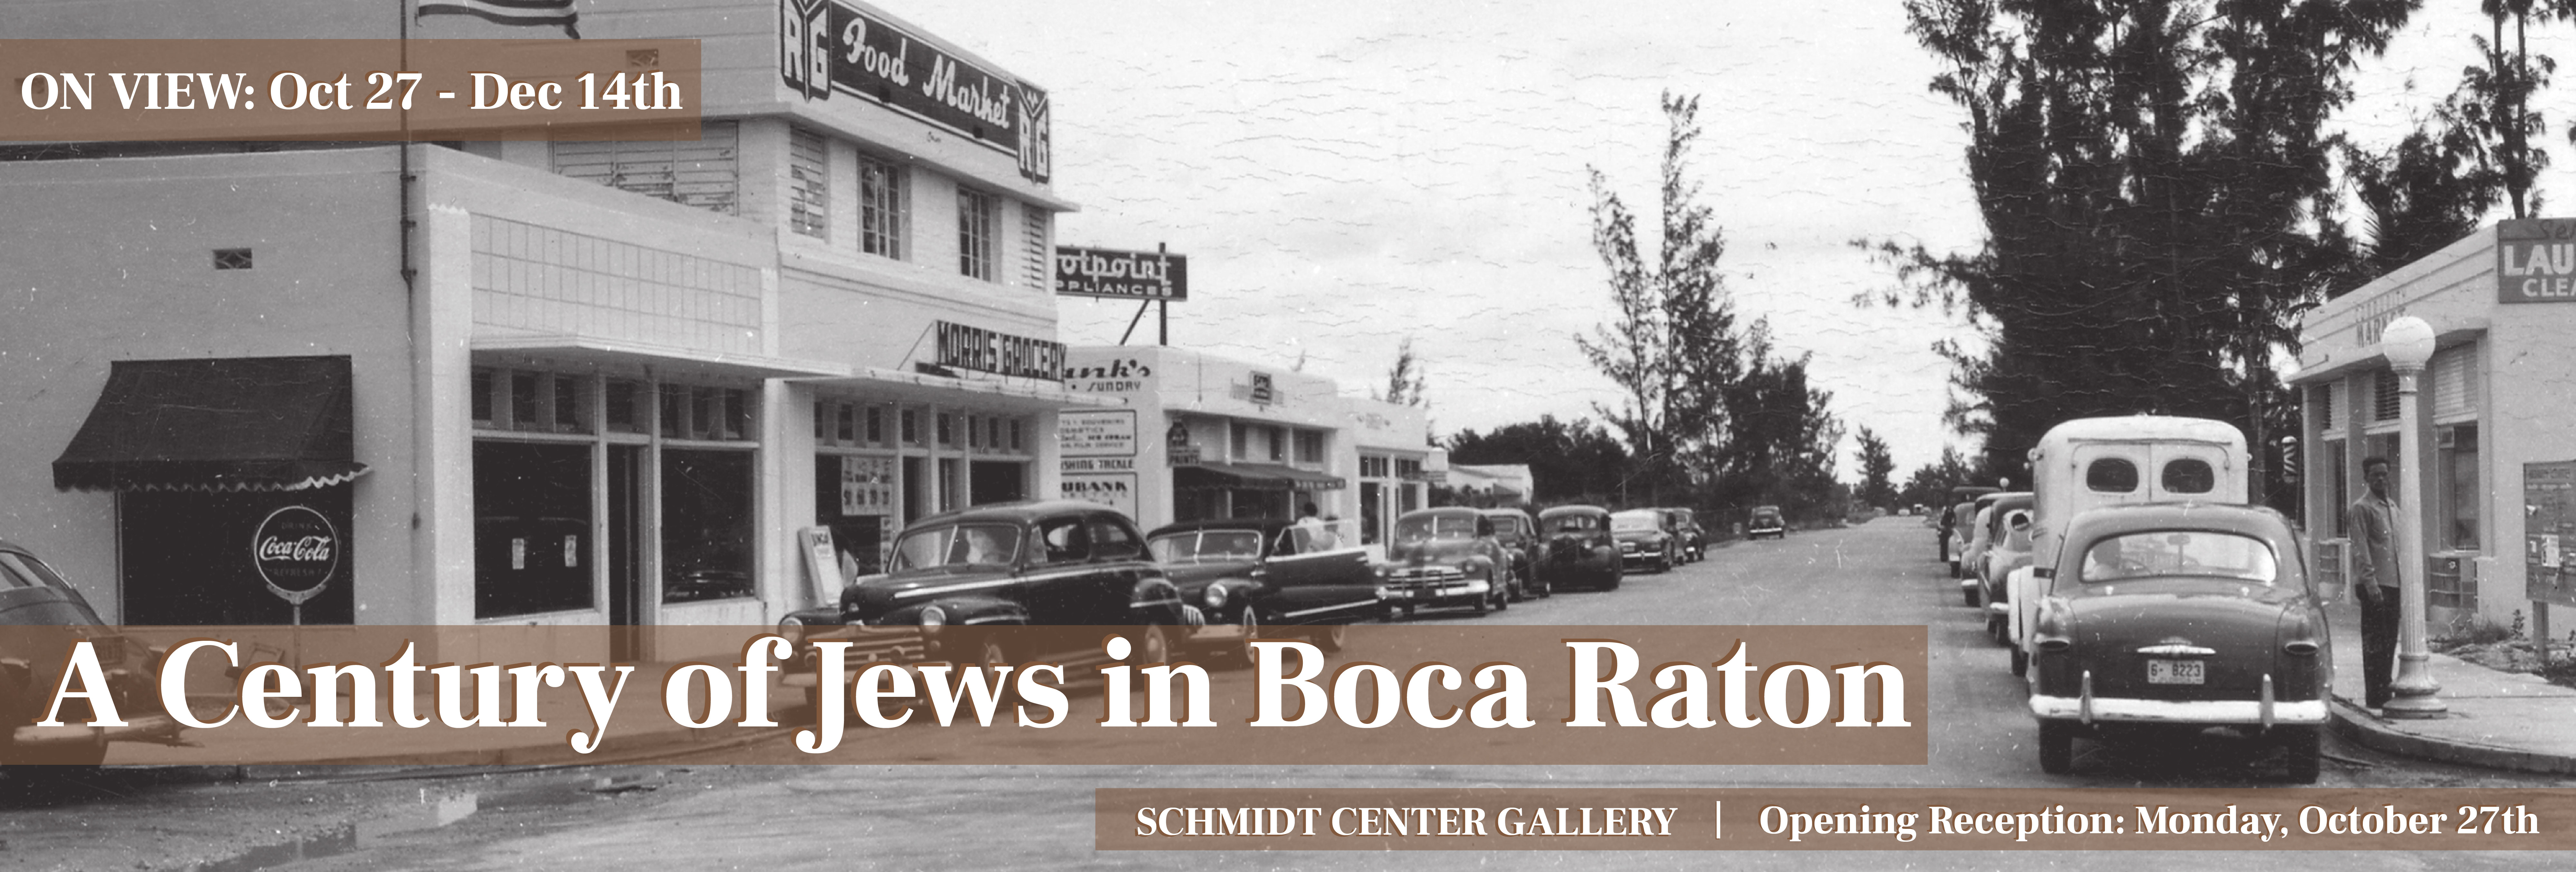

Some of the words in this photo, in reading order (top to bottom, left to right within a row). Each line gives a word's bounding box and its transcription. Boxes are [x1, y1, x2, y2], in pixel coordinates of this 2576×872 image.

[843, 17, 909, 86] Food
[923, 54, 1009, 128] Market
[2504, 244, 2574, 275] LAU
[1087, 381, 1141, 392] SUNDRY
